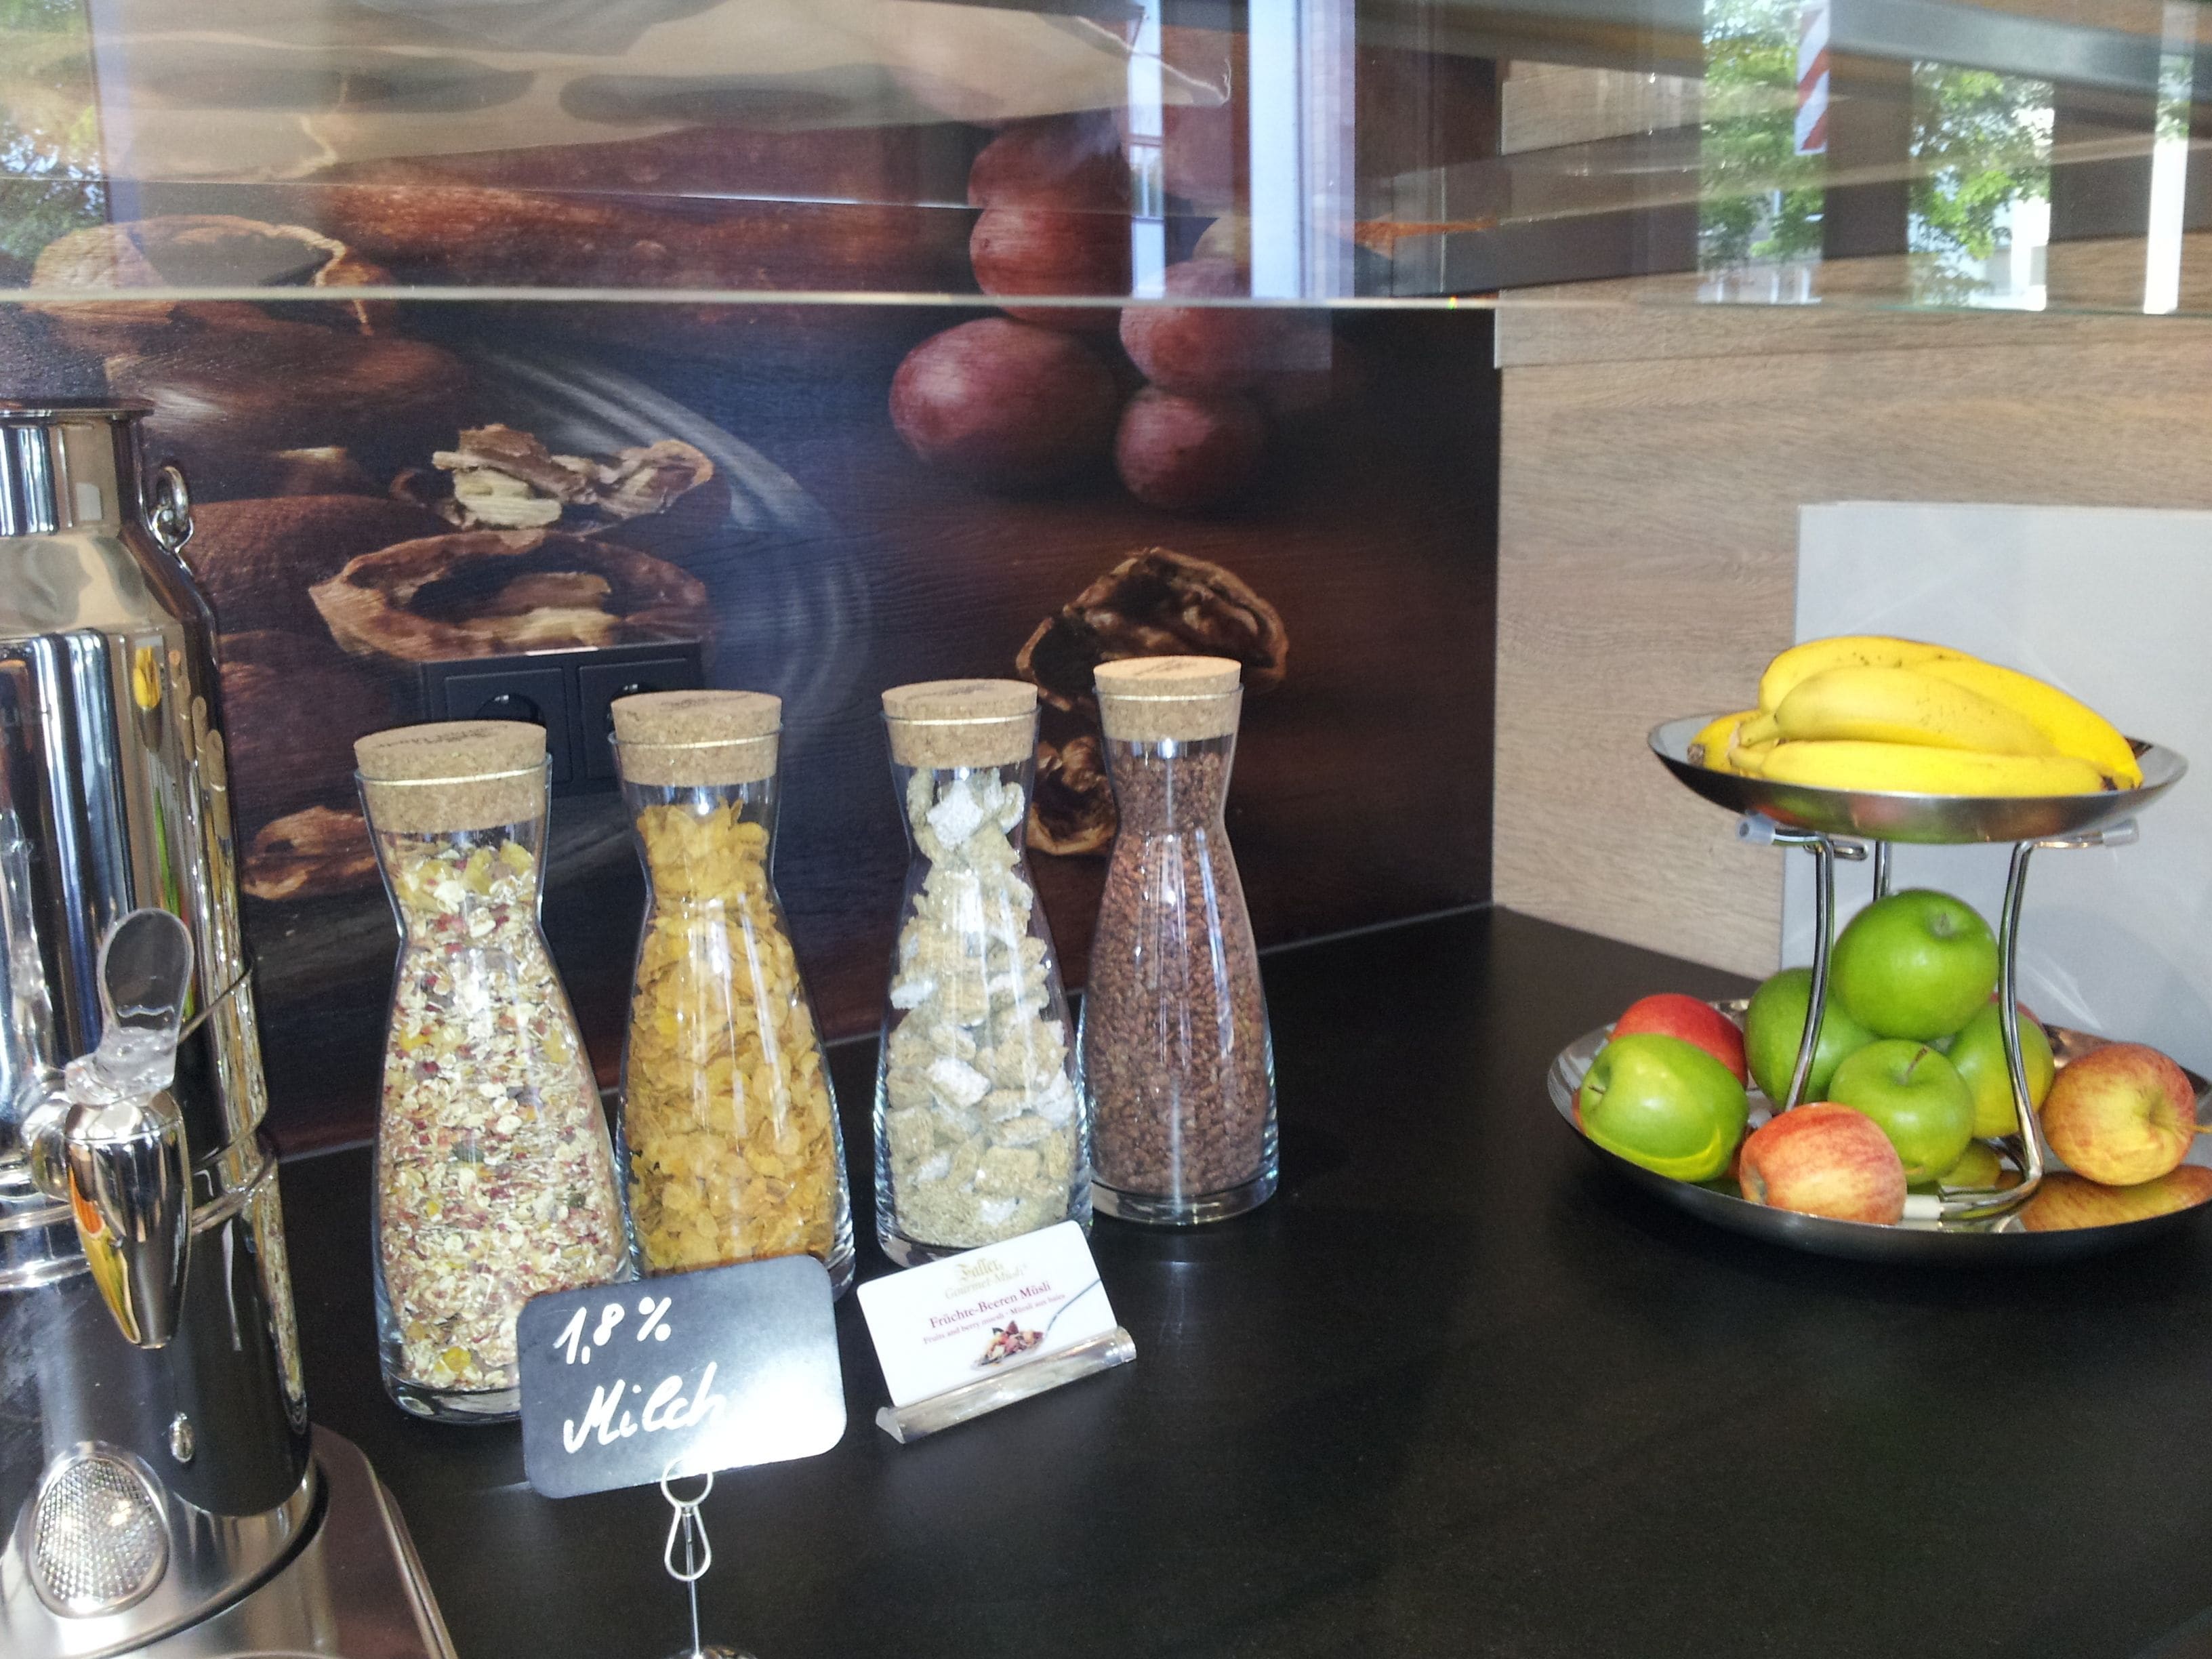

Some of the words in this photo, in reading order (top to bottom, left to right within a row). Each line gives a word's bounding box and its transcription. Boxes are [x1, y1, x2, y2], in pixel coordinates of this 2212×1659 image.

[552, 1303, 625, 1365] 1,8
[636, 1296, 672, 1341] %
[929, 1294, 1018, 1328] Früchte-Beeren
[1019, 1279, 1051, 1299] Müsli
[947, 1326, 960, 1336] and
[961, 1322, 980, 1332] berry
[563, 1361, 727, 1454] Milch
